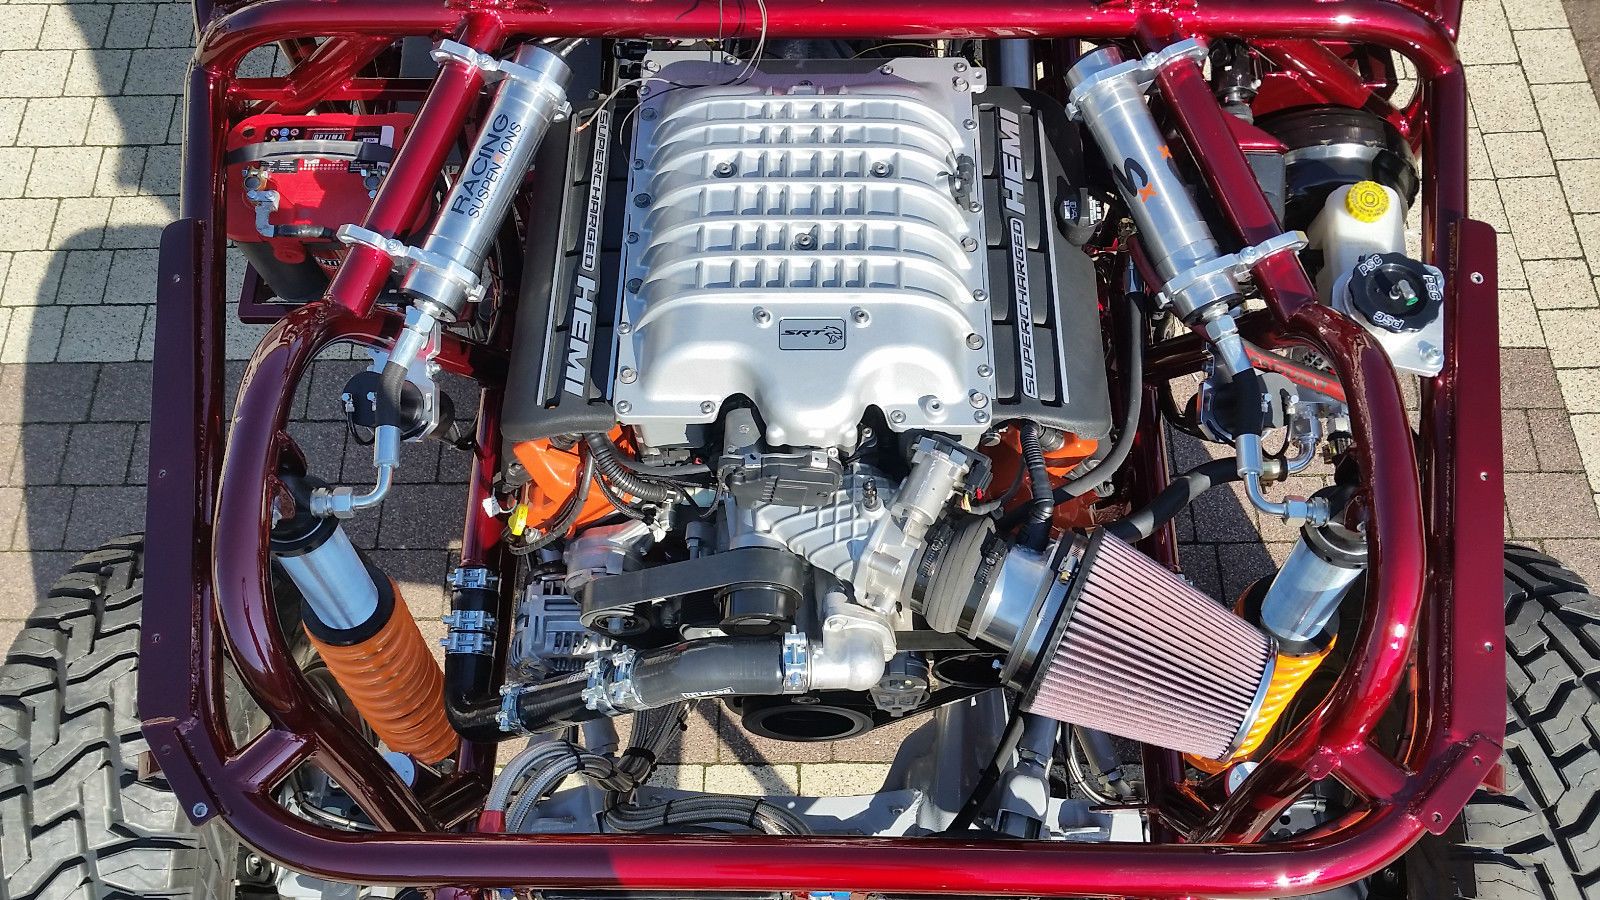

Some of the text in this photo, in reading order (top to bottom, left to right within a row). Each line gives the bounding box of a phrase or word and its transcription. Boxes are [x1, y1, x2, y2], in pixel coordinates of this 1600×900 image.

[312, 133, 345, 141] OPTIMA
[451, 113, 509, 215] RACING
[564, 110, 608, 397] SUPERCHARGED HEMI
[999, 107, 1035, 396] SUPERCHARGED HEMI
[1358, 254, 1383, 276] PSC
[1423, 274, 1442, 301] PSC
[1373, 311, 1404, 330] PSC
[780, 329, 825, 338] SRT
